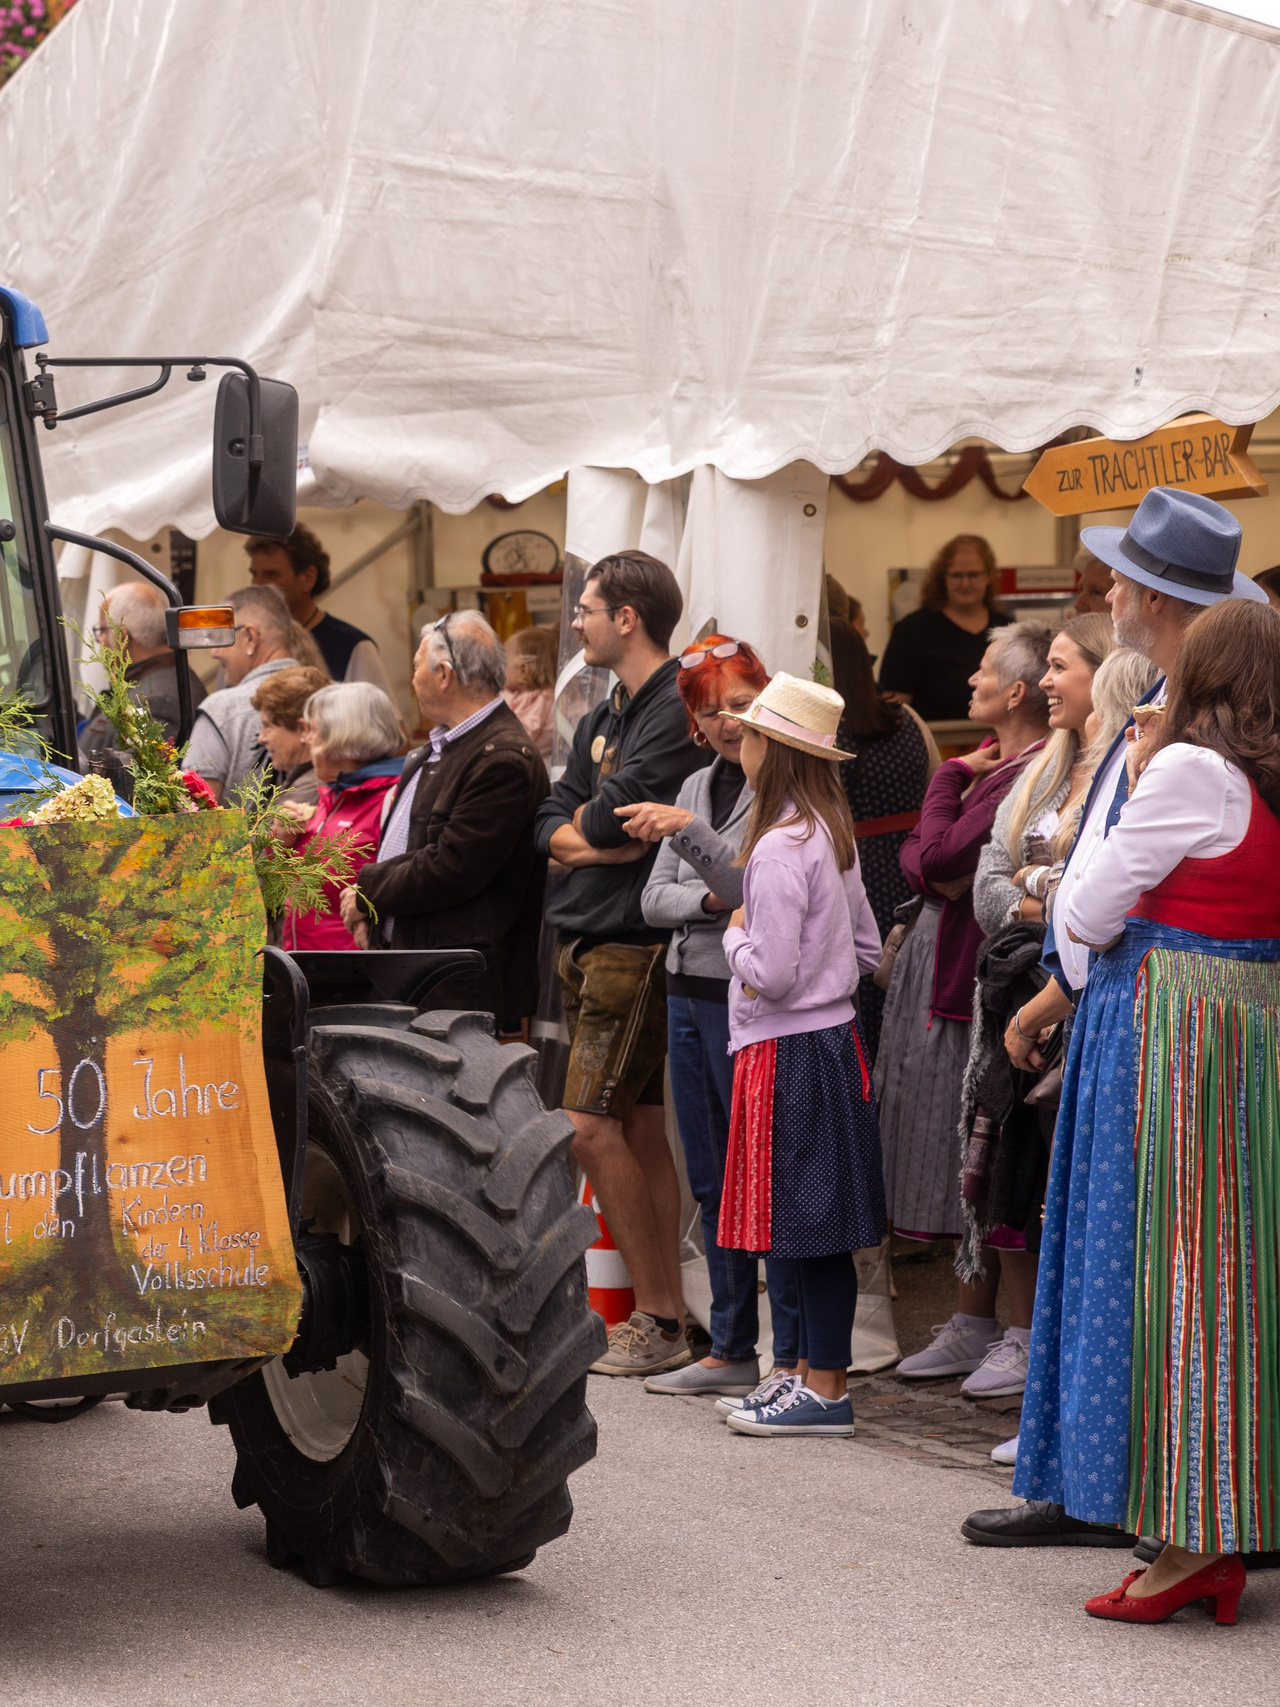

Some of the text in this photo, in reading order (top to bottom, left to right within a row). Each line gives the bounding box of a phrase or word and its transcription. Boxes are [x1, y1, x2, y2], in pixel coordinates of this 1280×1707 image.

[1056, 468, 1084, 492] ZUR
[26, 1052, 240, 1135] 50 Jahre
[33, 1212, 75, 1239] den
[120, 1196, 205, 1238] Kindern
[141, 1236, 171, 1261] der
[198, 1220, 261, 1256] Klasse
[131, 1250, 270, 1296] Volksschule
[57, 1305, 207, 1353] Dorfgastein
